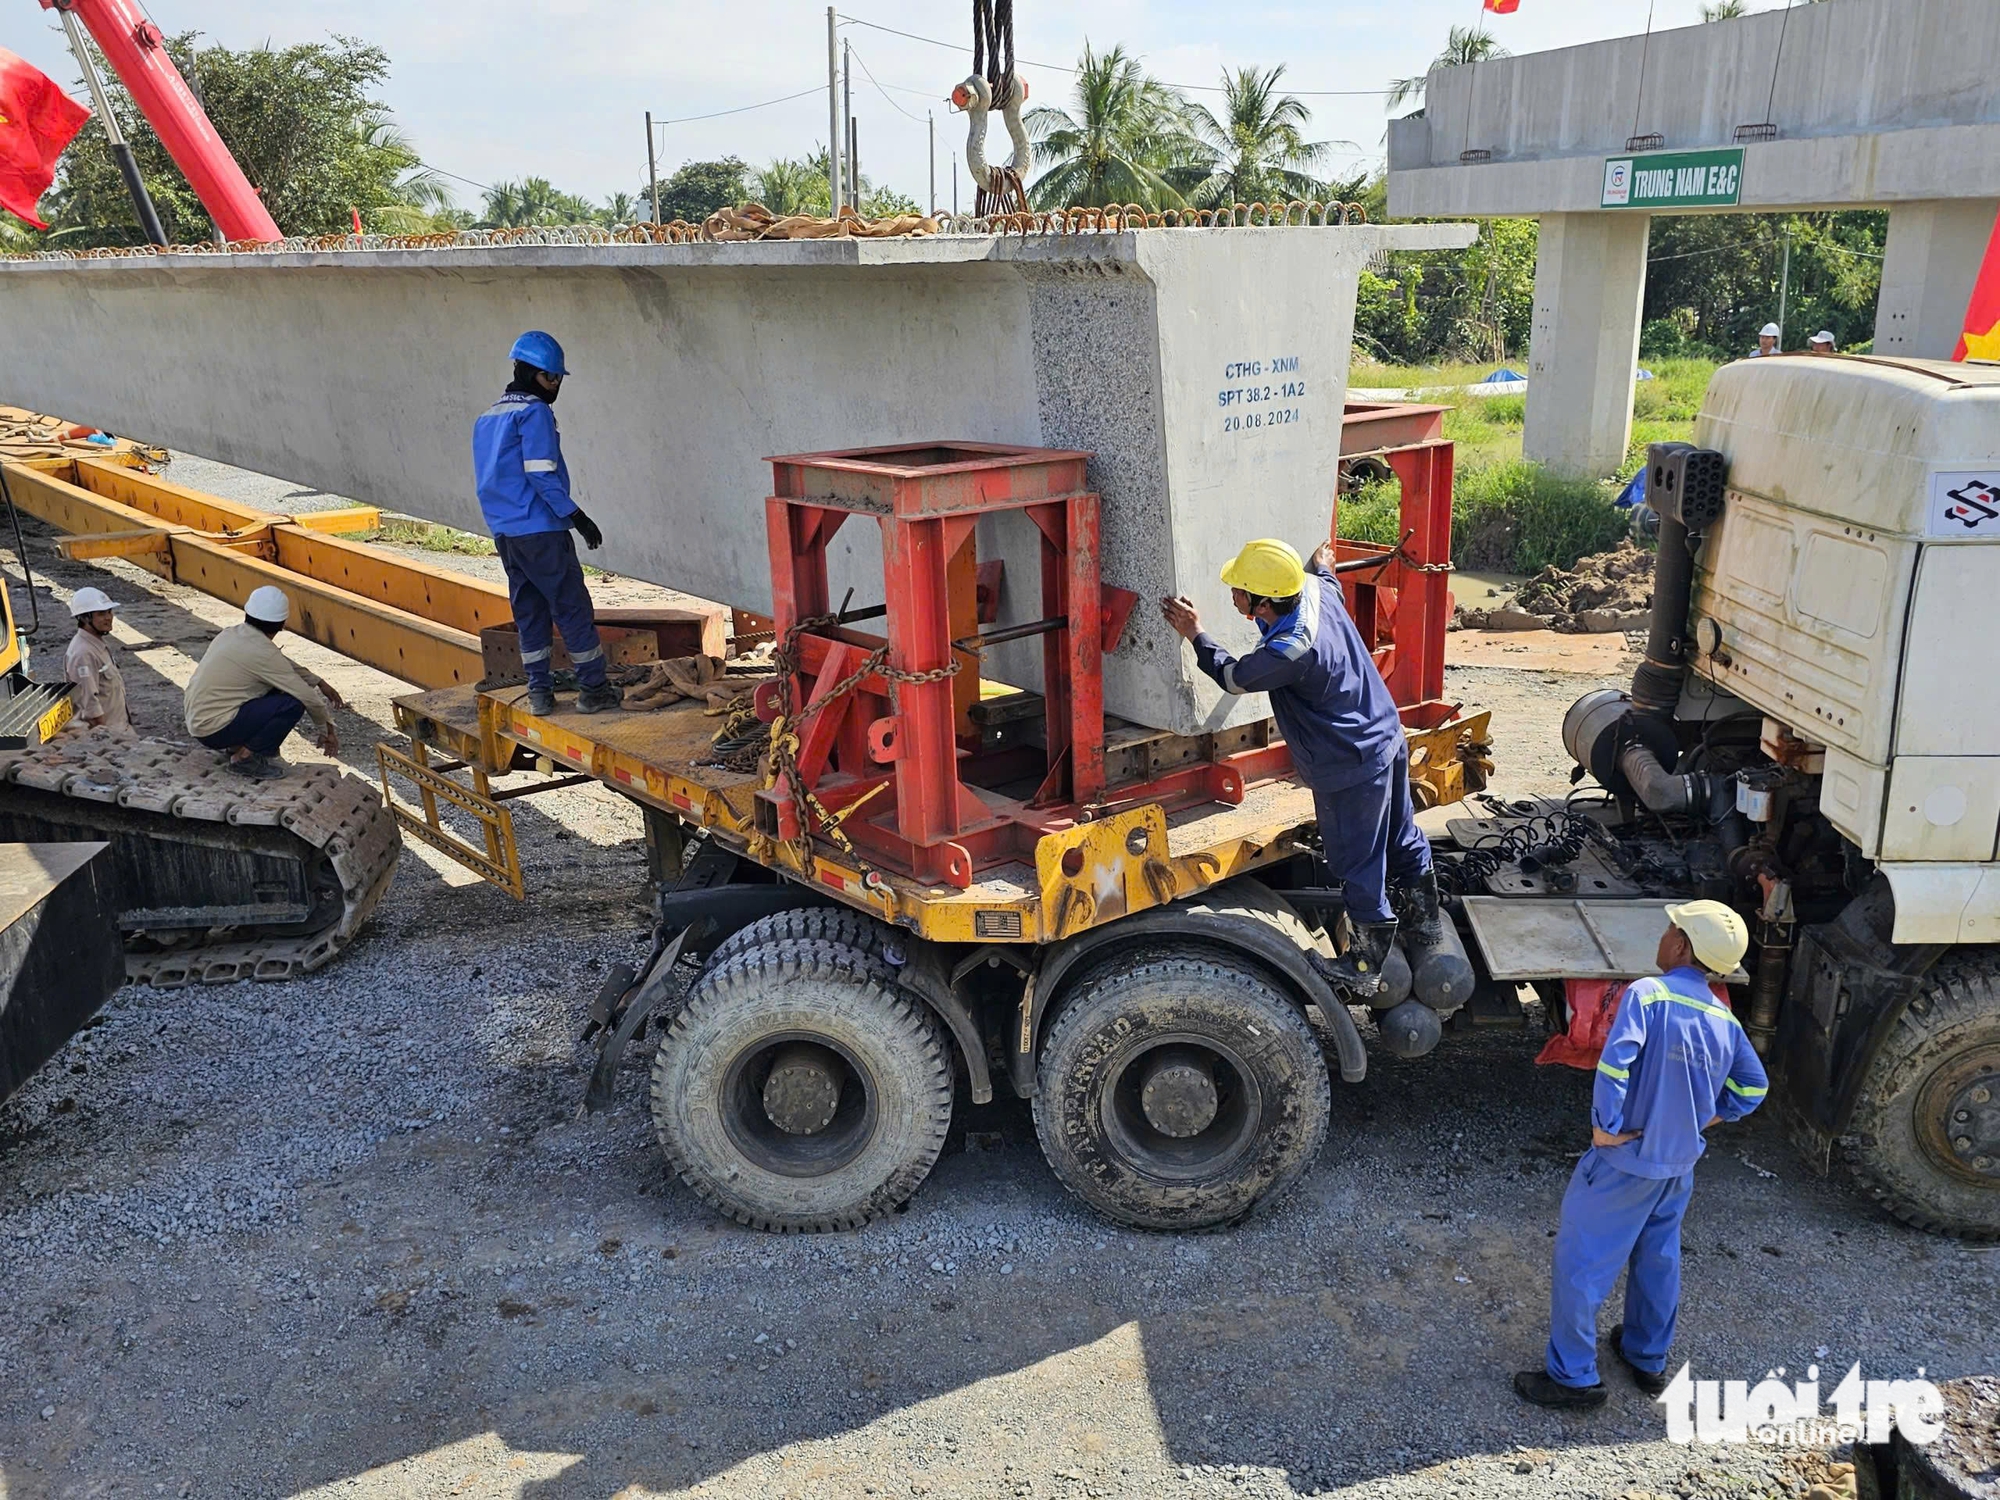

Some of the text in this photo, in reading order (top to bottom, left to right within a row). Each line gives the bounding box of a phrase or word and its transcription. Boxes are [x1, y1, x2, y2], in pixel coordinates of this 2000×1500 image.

[1633, 164, 1738, 199] TRUNG NAM E&C
[1225, 361, 1261, 380] CTHG
[1272, 356, 1299, 374] XNM
[1218, 389, 1243, 407] SPT
[1246, 386, 1270, 403] 38.2
[1224, 408, 1299, 432] 20.08.2024
